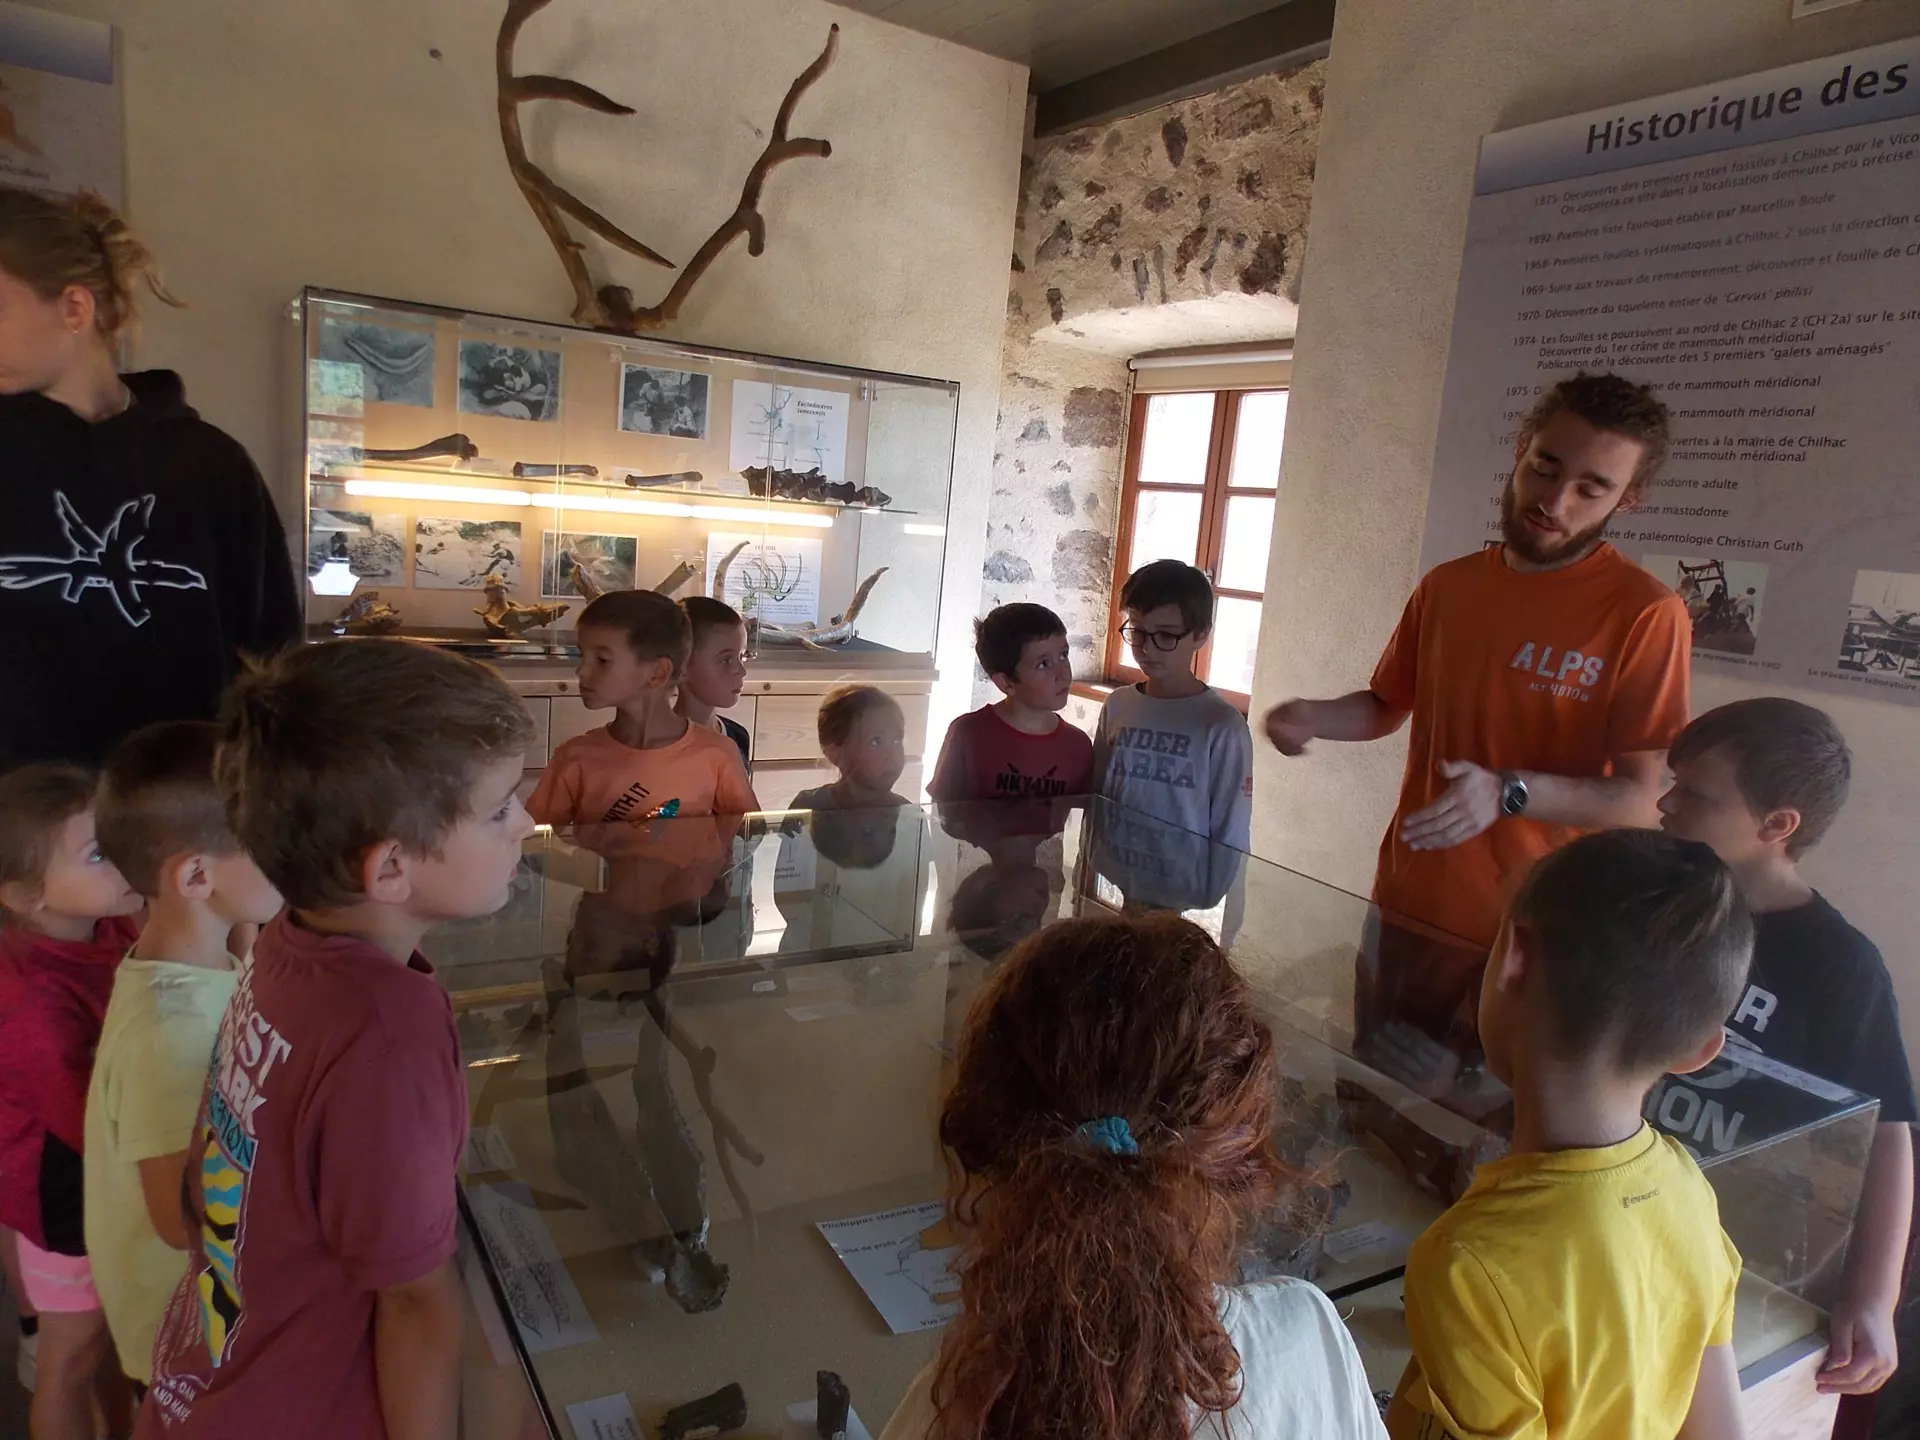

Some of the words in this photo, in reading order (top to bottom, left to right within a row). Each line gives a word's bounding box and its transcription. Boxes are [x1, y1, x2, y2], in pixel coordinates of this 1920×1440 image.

[1586, 87, 1802, 154] Historique
[1820, 64, 1908, 106] des
[1643, 172, 1690, 188] premiers
[1694, 166, 1727, 179] restes
[1732, 157, 1777, 174] fossiles
[1792, 148, 1839, 163] Chilhac
[1844, 141, 1867, 155] par
[1871, 137, 1884, 148] le
[1660, 186, 1684, 199] dont
[1688, 184, 1698, 195] la
[1702, 172, 1768, 193] localisation
[1772, 161, 1829, 180] demeure
[1832, 157, 1857, 172] peu
[1602, 222, 1624, 235] liste
[1626, 215, 1673, 232] faunique
[1676, 208, 1714, 224] établie
[1717, 206, 1737, 220] par
[1740, 197, 1795, 215] Marcellin
[1800, 191, 1836, 207] Boule
[1602, 247, 1640, 262] fouilles
[1643, 236, 1722, 257] systématiques
[1736, 230, 1781, 245] Chilhac
[1797, 223, 1828, 237] sous
[1831, 220, 1843, 233] la
[1846, 212, 1910, 232] direction
[1549, 282, 1573, 294] Suite
[1574, 280, 1593, 291] aux
[1595, 275, 1634, 289] travaux
[1636, 272, 1650, 284] de
[1745, 255, 1816, 273] découverte
[1819, 253, 1833, 266] et
[1836, 248, 1880, 263] fouille
[1883, 245, 1901, 259] de
[1545, 304, 1600, 320] Découverte
[1602, 303, 1614, 315] du
[1617, 298, 1666, 314] squelette
[1668, 294, 1702, 308] entier
[1704, 292, 1719, 305] de
[1540, 334, 1557, 345] Les
[1559, 330, 1595, 345] fouilles
[1597, 329, 1609, 341] se
[1610, 326, 1673, 342] poursuivent
[1676, 324, 1690, 335] au
[1692, 321, 1720, 335] nord
[1723, 320, 1738, 333] de
[1741, 316, 1787, 332] Chilhac
[1789, 316, 1799, 328] 2
[1802, 314, 1826, 328] (CH
[1830, 312, 1852, 327] 2a)
[1855, 311, 1879, 324] sur
[1881, 309, 1895, 322] le
[1538, 343, 1593, 358] Découverte
[1594, 342, 1608, 354] du
[1611, 341, 1629, 353] 1er
[1630, 339, 1660, 352] crâne
[1662, 337, 1676, 350] de
[1679, 332, 1745, 348] mammouth
[1748, 329, 1815, 345] méridional
[1536, 355, 1589, 370] Publication
[1591, 355, 1605, 368] de
[1606, 354, 1616, 367] la
[1618, 351, 1676, 367] découverte
[1679, 350, 1699, 363] des
[1702, 349, 1710, 362] 5
[1713, 347, 1766, 363] premiers
[1667, 379, 1682, 391] de
[1684, 378, 1750, 391] mammouth
[1753, 375, 1822, 388] méridional
[1679, 406, 1745, 419] mammouth
[1748, 404, 1817, 418] méridional
[1499, 435, 1515, 446] 197
[1712, 436, 1721, 447] à
[1723, 435, 1734, 447] la
[1737, 435, 1776, 448] mairie
[1778, 436, 1795, 448] de
[1797, 435, 1847, 449] Chilhac
[1672, 450, 1737, 462] mammouth
[1740, 450, 1806, 463] méridional
[1493, 473, 1513, 482] 197
[1701, 477, 1740, 490] adulte
[1662, 505, 1730, 518] mastodonte
[1602, 528, 1621, 539] sée
[1623, 529, 1637, 541] de
[1638, 530, 1714, 547] paléontologie
[1716, 534, 1770, 550] Christian
[1773, 538, 1805, 552] Guth
[1509, 641, 1604, 687] ALPS
[1807, 667, 1819, 677] Le
[1821, 668, 1849, 681] travail
[1864, 675, 1917, 692] laboratoire
[1115, 726, 1192, 758] NDER
[629, 781, 651, 800] IT
[1644, 1078, 1746, 1152] ION
